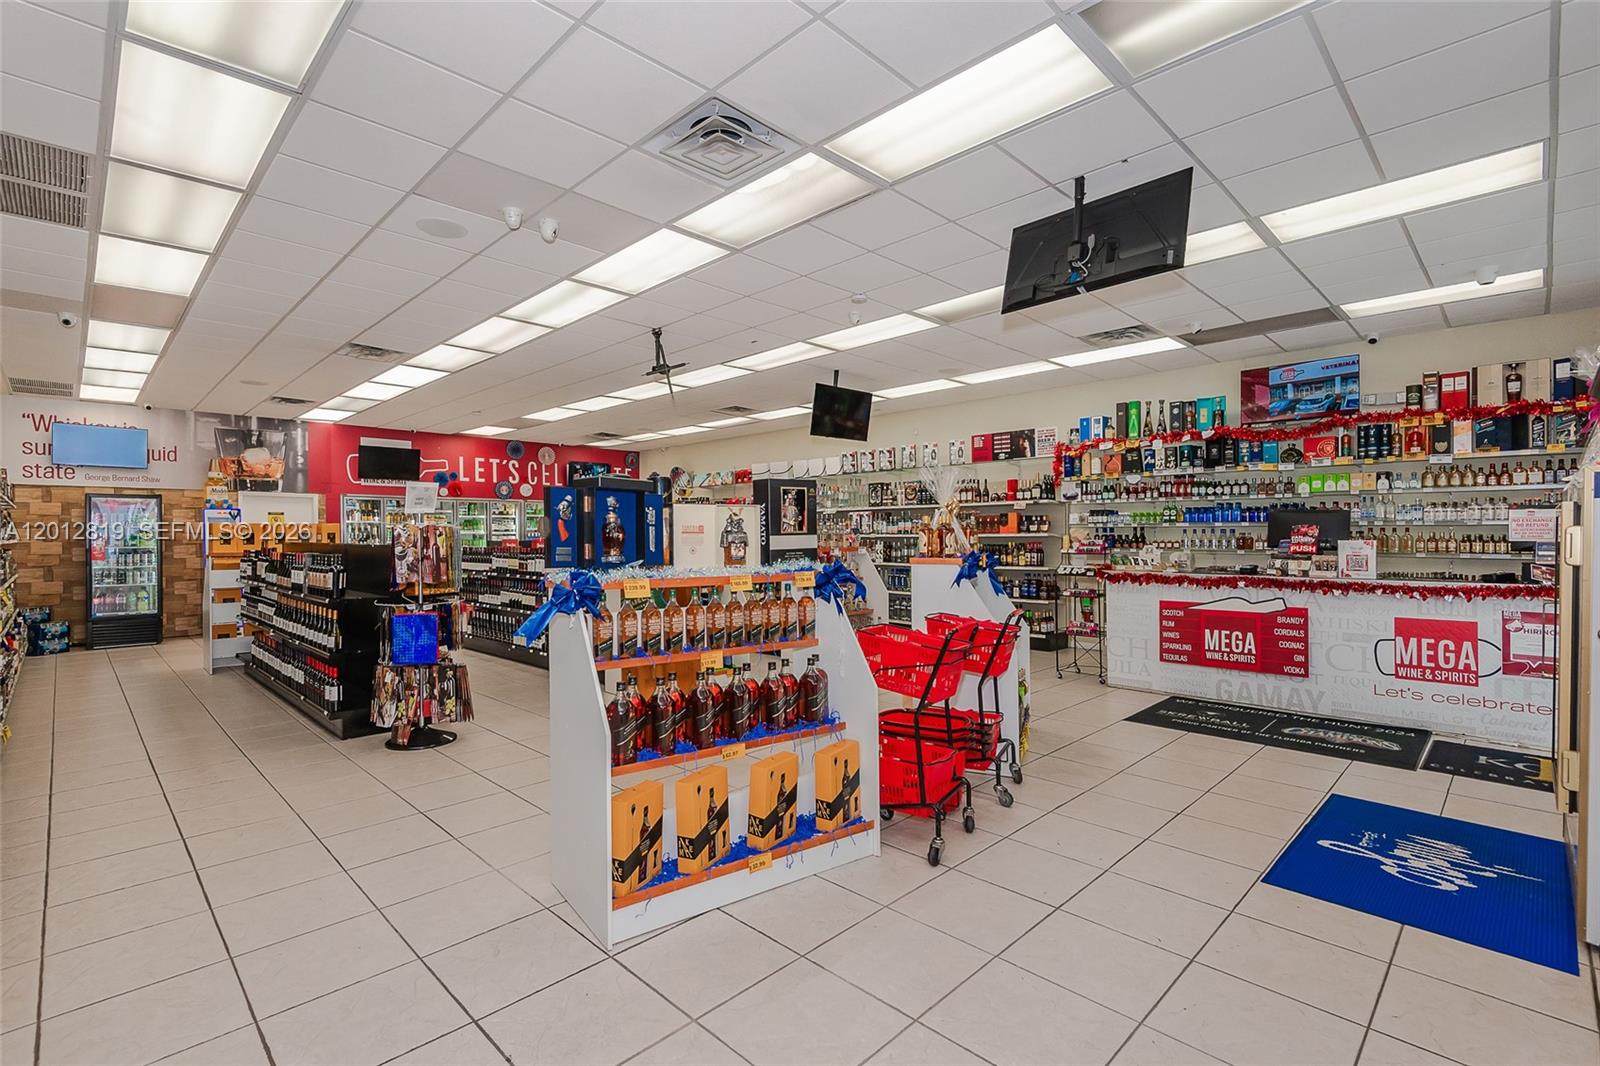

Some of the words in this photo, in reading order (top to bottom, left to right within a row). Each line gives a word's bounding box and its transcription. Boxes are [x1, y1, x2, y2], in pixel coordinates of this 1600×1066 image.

[458, 456, 520, 484] LET'S
[84, 473, 111, 483] George
[112, 474, 141, 483] Bernard
[141, 475, 161, 483] Shaw
[1162, 609, 1184, 617] SCOTCH
[1276, 616, 1304, 625] BRANDY
[1273, 628, 1305, 637] CORDIALS
[1162, 642, 1192, 651] SPARKLING
[1204, 629, 1256, 654] MEGA
[1278, 641, 1305, 650] COGNAC
[1162, 653, 1188, 662] TEQUILAS
[1205, 651, 1223, 661] WINE
[1223, 653, 1229, 661] &
[1229, 654, 1256, 664] SPIRITS
[1293, 654, 1305, 662] GIN
[1395, 636, 1477, 671] MEGA
[1283, 666, 1305, 675] VODKA
[1397, 667, 1424, 679] WINE
[1424, 669, 1433, 680] &
[1434, 670, 1476, 684] SPIRITS
[1215, 679, 1326, 713] GAMAY
[1373, 684, 1424, 701] Let's
[1431, 693, 1553, 716] celebrate
[1291, 715, 1321, 724] THE
[1324, 721, 1372, 731] HUNT
